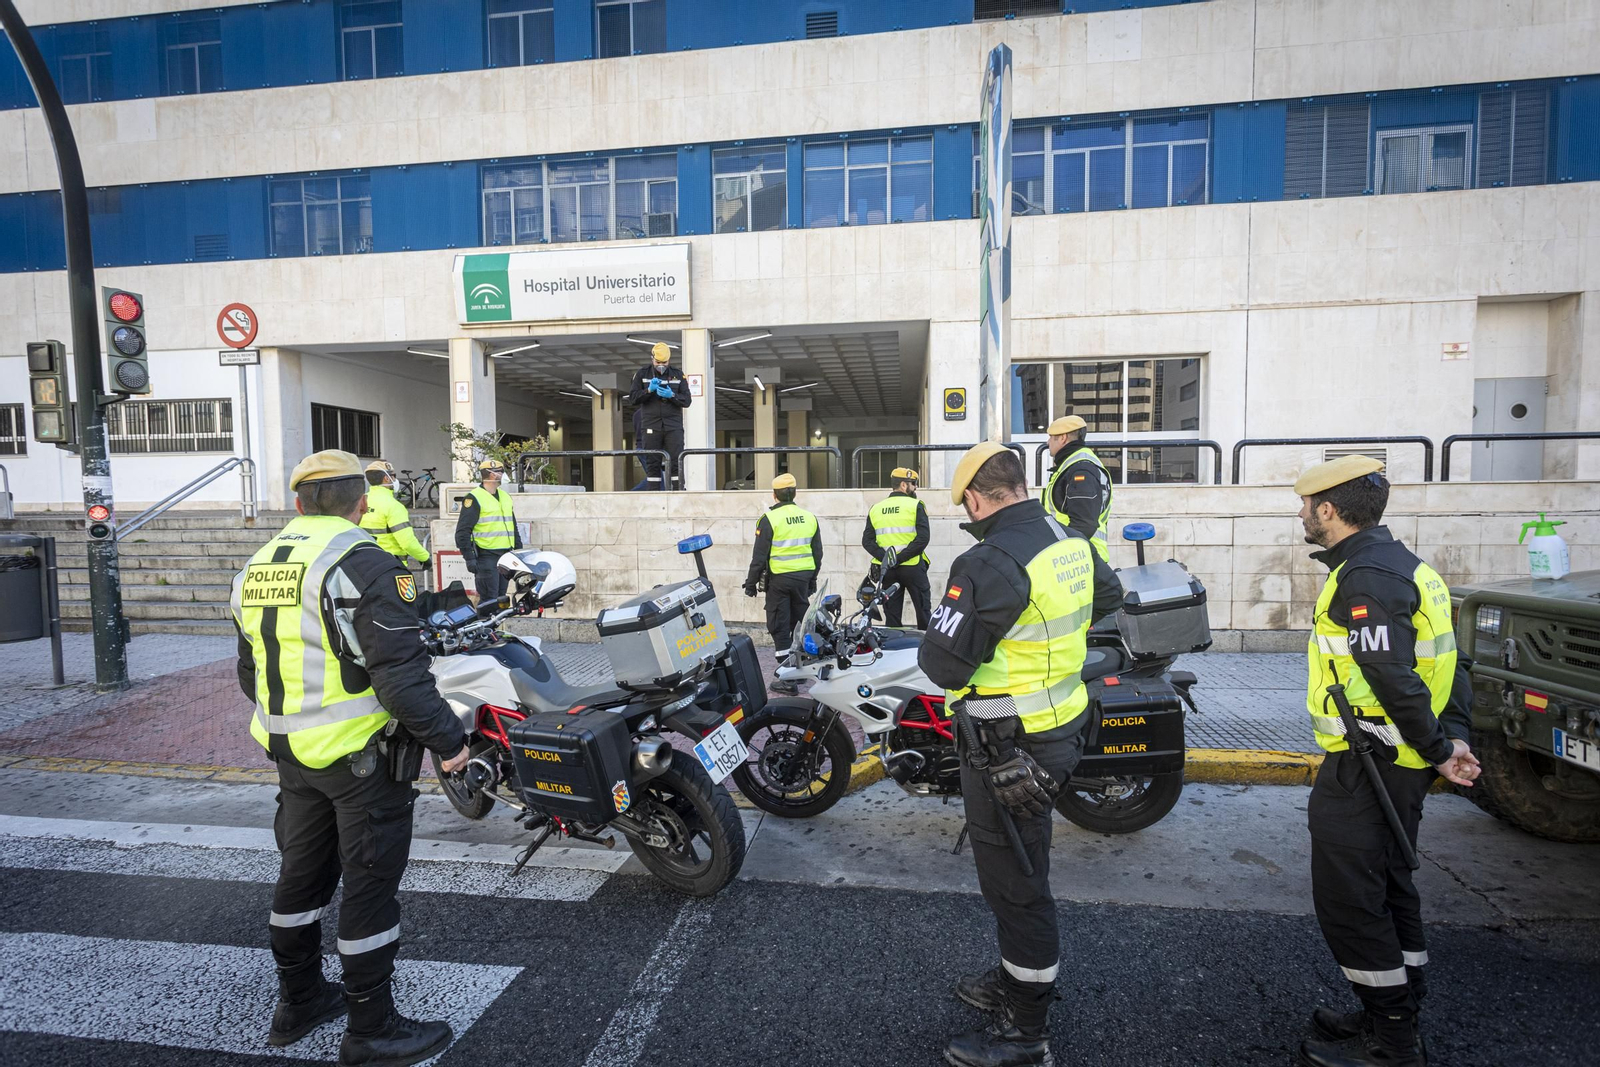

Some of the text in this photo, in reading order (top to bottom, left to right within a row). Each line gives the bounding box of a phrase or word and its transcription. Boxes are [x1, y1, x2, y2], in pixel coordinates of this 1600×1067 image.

[523, 272, 676, 295] Hospital Universitario
[603, 292, 676, 304] Puerta del Mar
[881, 506, 900, 515] UME
[786, 515, 806, 525] UME
[1052, 550, 1087, 569] POLICIA
[247, 570, 298, 583] POLICIA
[1056, 563, 1091, 583] MILITAR
[244, 587, 296, 600] MILITAR
[1069, 580, 1087, 595] UME
[930, 604, 964, 638] PM
[676, 622, 716, 650] POLICIA
[1348, 625, 1390, 652] PM
[680, 631, 718, 659] MILITAR
[1101, 716, 1147, 728] POLICIA
[709, 730, 728, 752] ET
[524, 749, 562, 763] POLICIA
[1103, 743, 1147, 755] MILITAR
[714, 740, 748, 775] 119571
[535, 781, 573, 795] MILITAR
